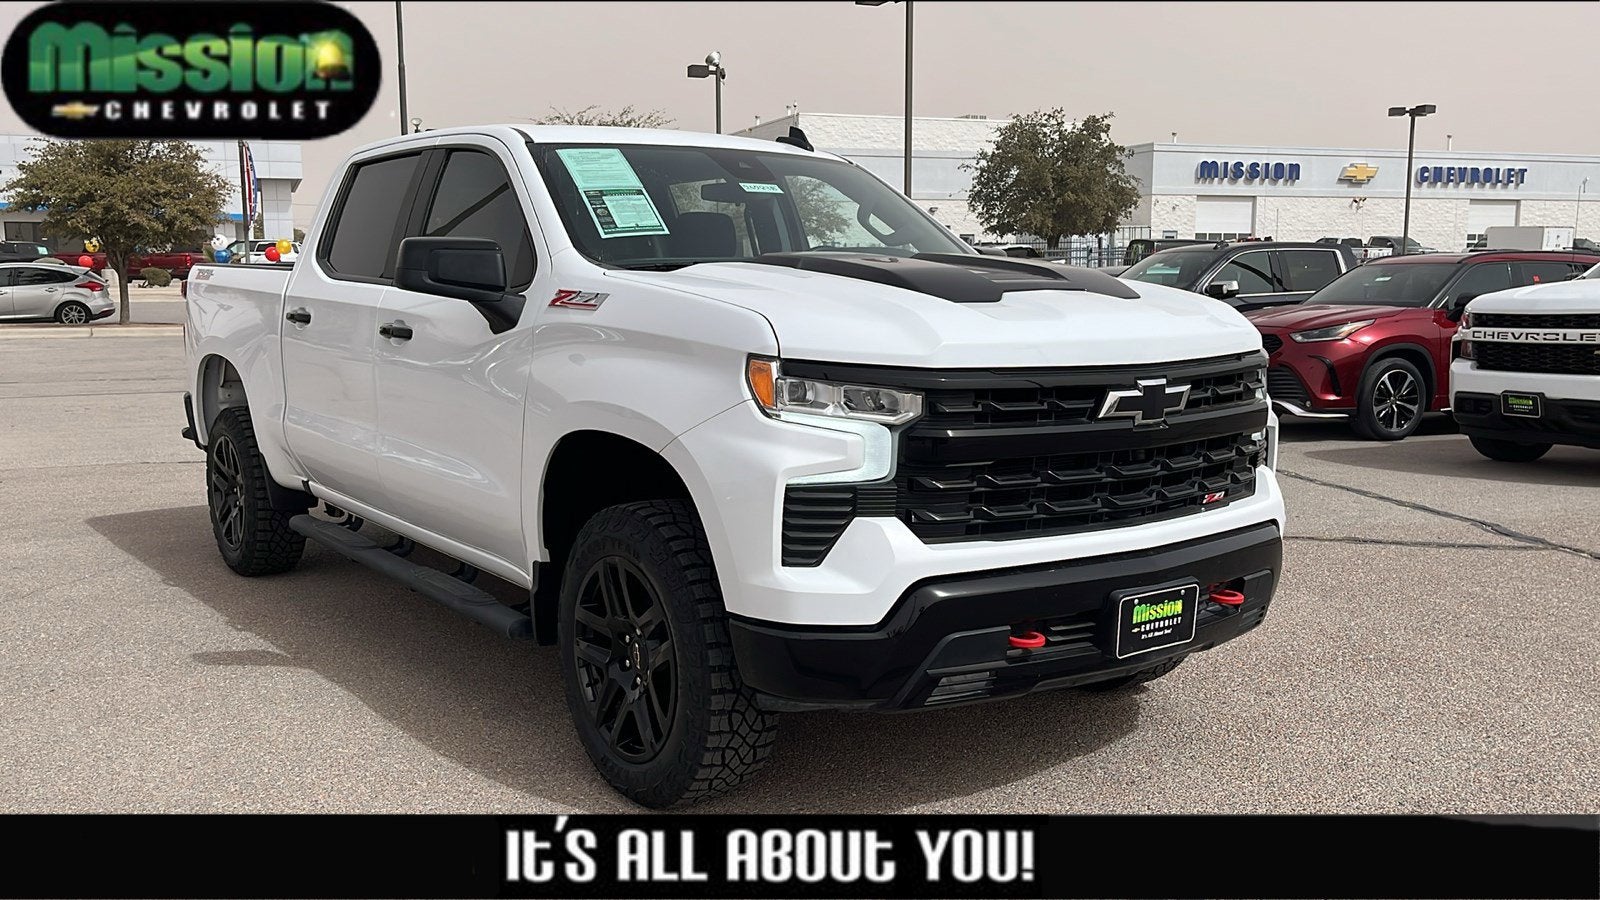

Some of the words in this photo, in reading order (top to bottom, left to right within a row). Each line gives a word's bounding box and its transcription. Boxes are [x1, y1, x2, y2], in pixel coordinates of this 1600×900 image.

[1199, 160, 1301, 181] MISSION
[1419, 165, 1528, 185] CHEVROLET
[1471, 330, 1600, 342] CHEVROLE
[1132, 599, 1183, 625] Mission
